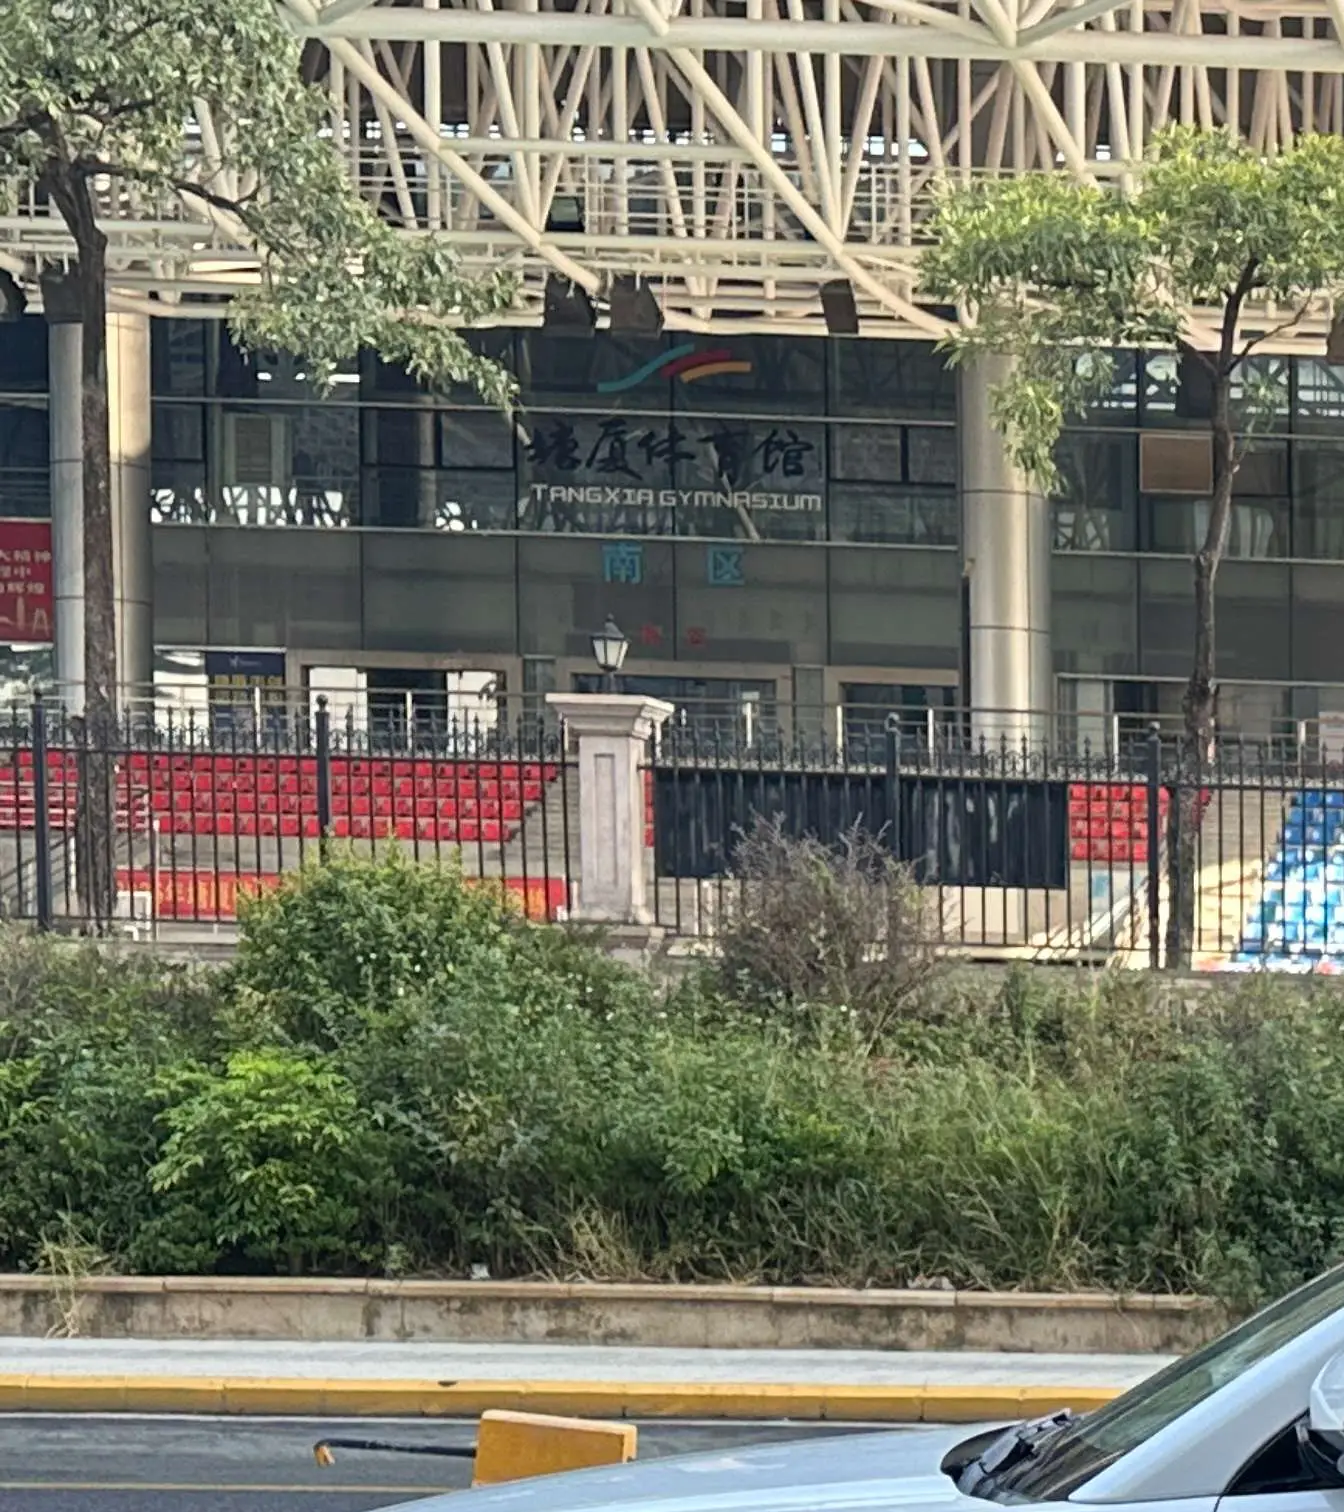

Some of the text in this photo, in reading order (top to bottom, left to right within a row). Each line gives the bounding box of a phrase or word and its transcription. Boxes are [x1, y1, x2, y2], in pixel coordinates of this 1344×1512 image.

[530, 483, 823, 511] TANGXIA GYMNASIUM
[602, 541, 746, 586] 南区
